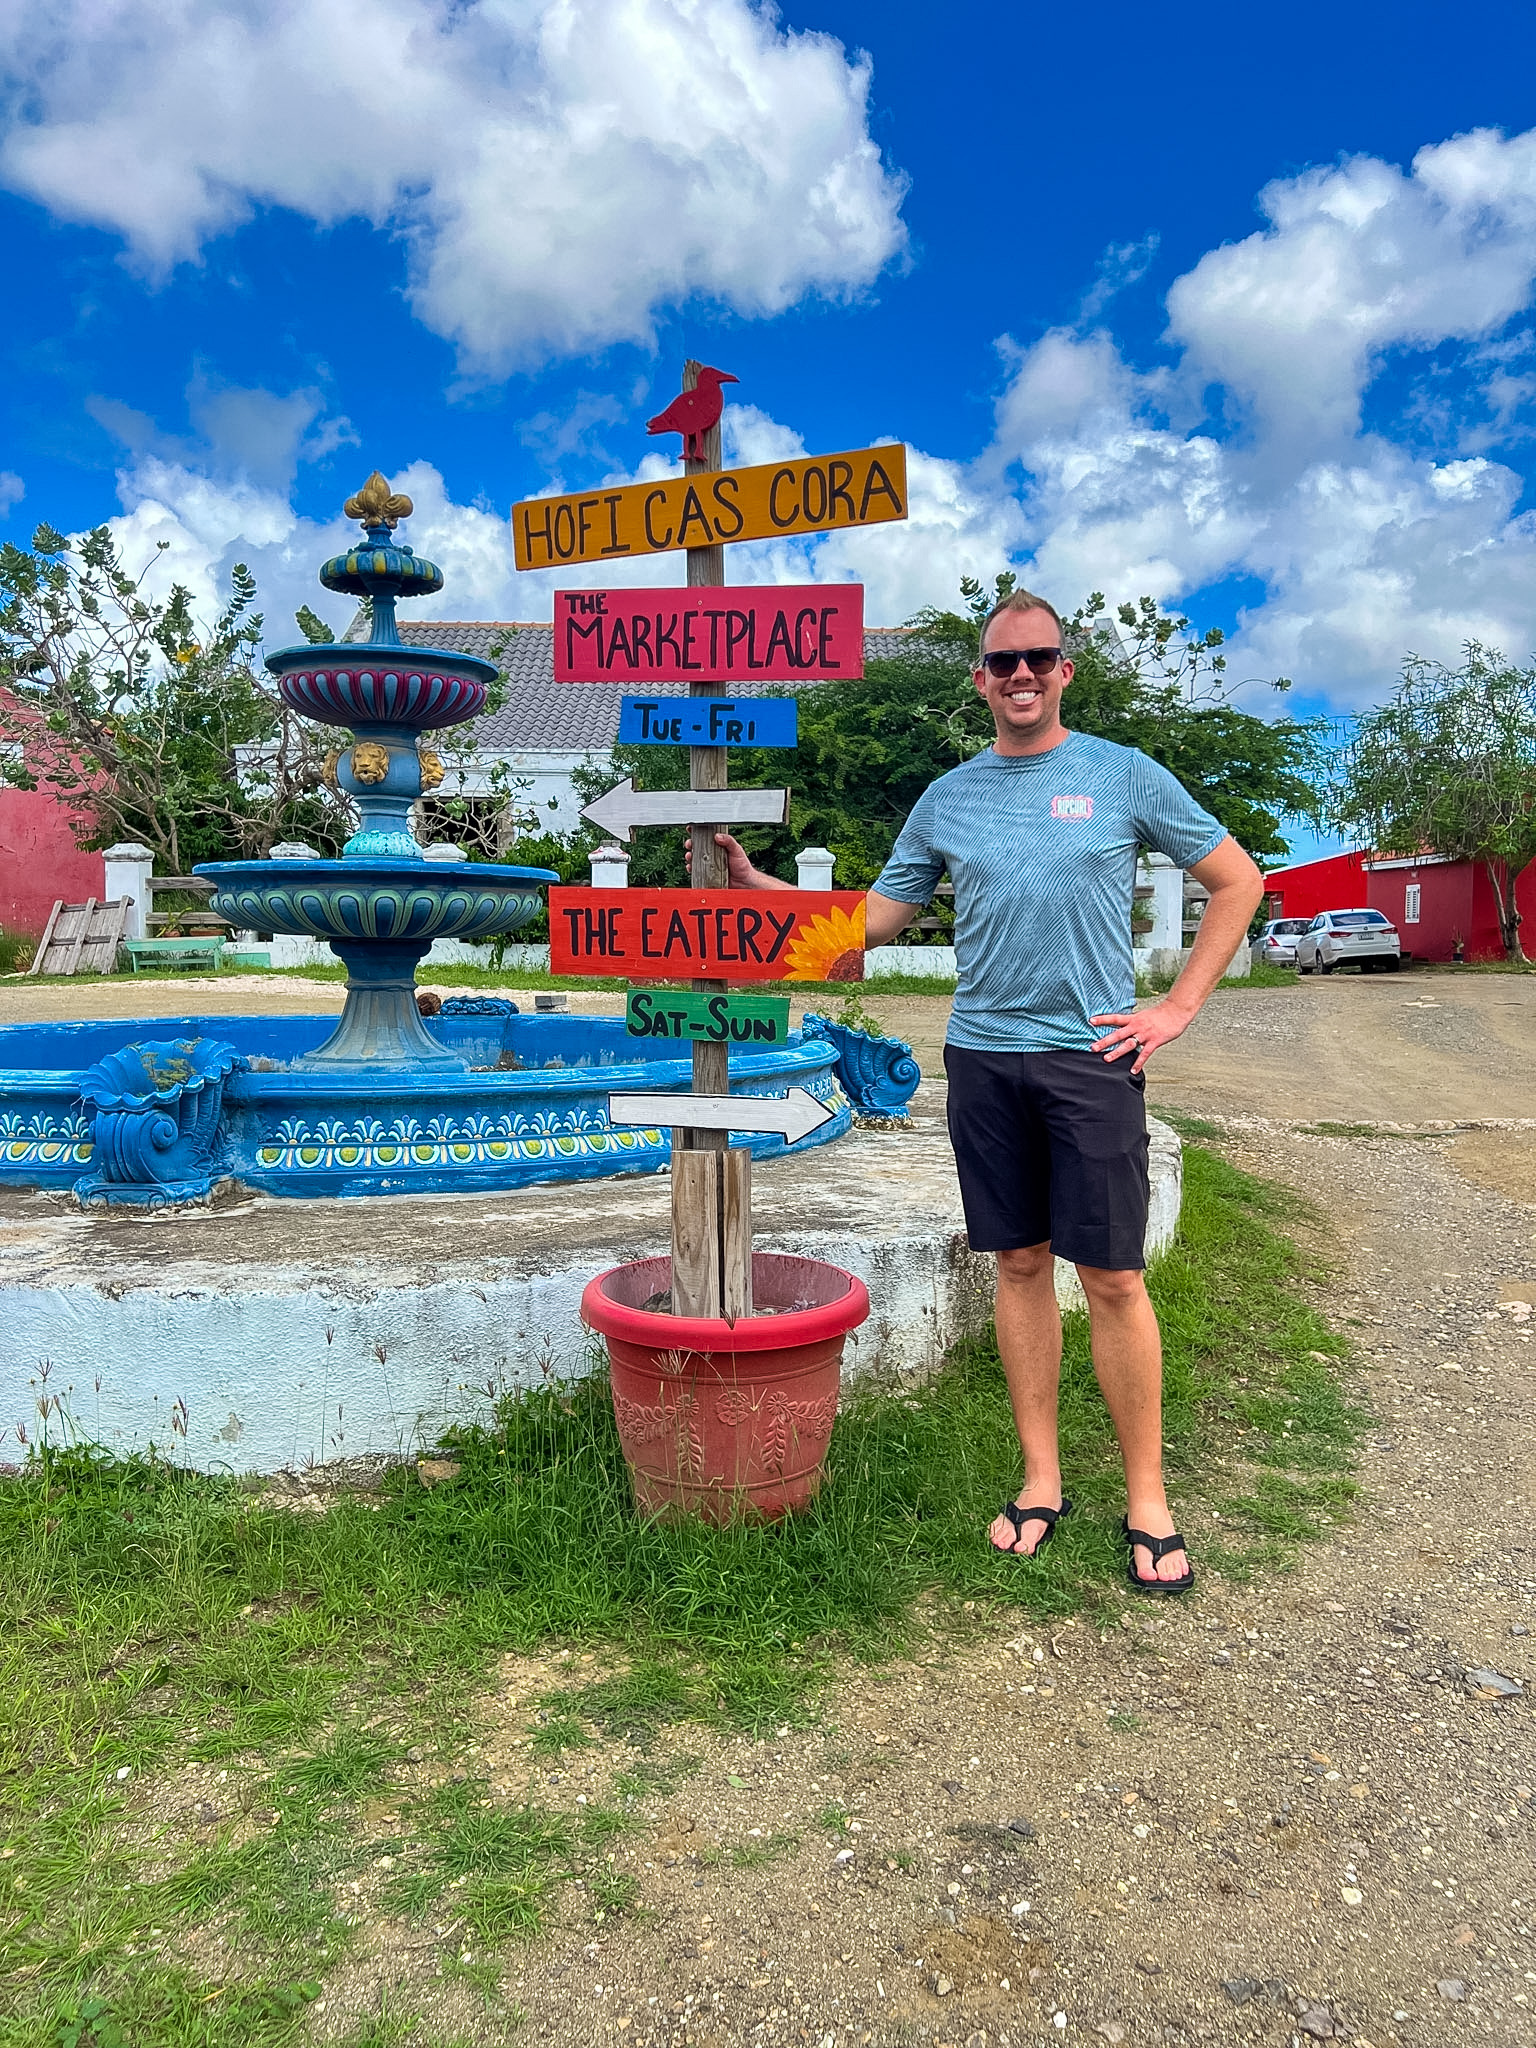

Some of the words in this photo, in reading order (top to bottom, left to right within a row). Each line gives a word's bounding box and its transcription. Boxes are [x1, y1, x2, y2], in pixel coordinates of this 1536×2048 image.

[525, 494, 630, 562] HOFI
[644, 476, 744, 549] CAS
[769, 460, 902, 528] CORA
[564, 593, 608, 615] THE
[566, 607, 840, 669] MARKETPLACE
[563, 908, 625, 957] THE
[641, 908, 796, 963] EATERY
